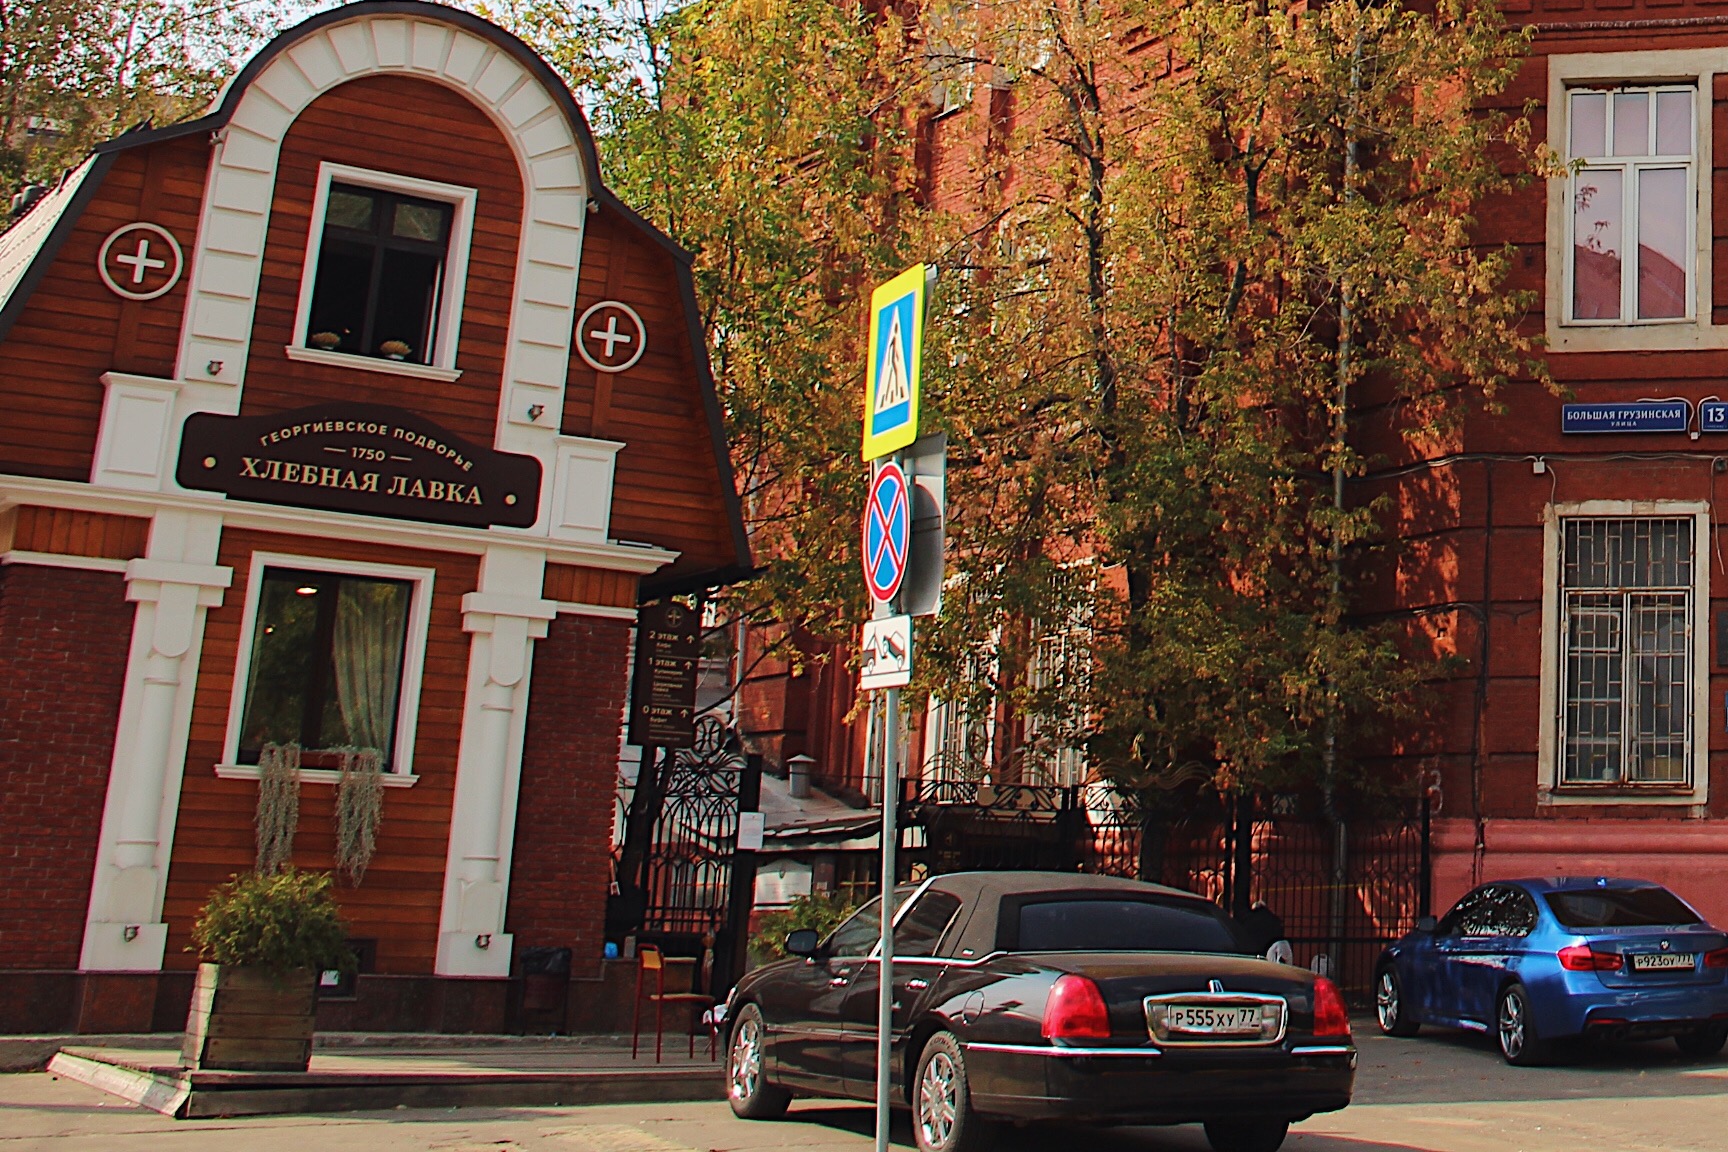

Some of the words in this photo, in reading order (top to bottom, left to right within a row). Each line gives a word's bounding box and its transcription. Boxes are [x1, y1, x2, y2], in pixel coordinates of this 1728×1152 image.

[1567, 410, 1615, 421] БОЛЬШАЯ
[1617, 409, 1681, 419] ГРУЗИНСКАЯ
[1707, 407, 1725, 423] 13
[260, 421, 388, 447] ГЕОРГИЕВСКОЕ
[393, 428, 474, 472] ПОДВОРЬЕ
[351, 447, 386, 462] 1750
[239, 457, 379, 492] ХЛЕБНАЯ
[387, 476, 483, 505] ЛАВКА
[649, 630, 656, 639] 2
[657, 633, 679, 641] этаж
[655, 659, 677, 667] этаж
[1175, 1009, 1235, 1027] Р555ХУ
[1240, 1009, 1255, 1023] 77
